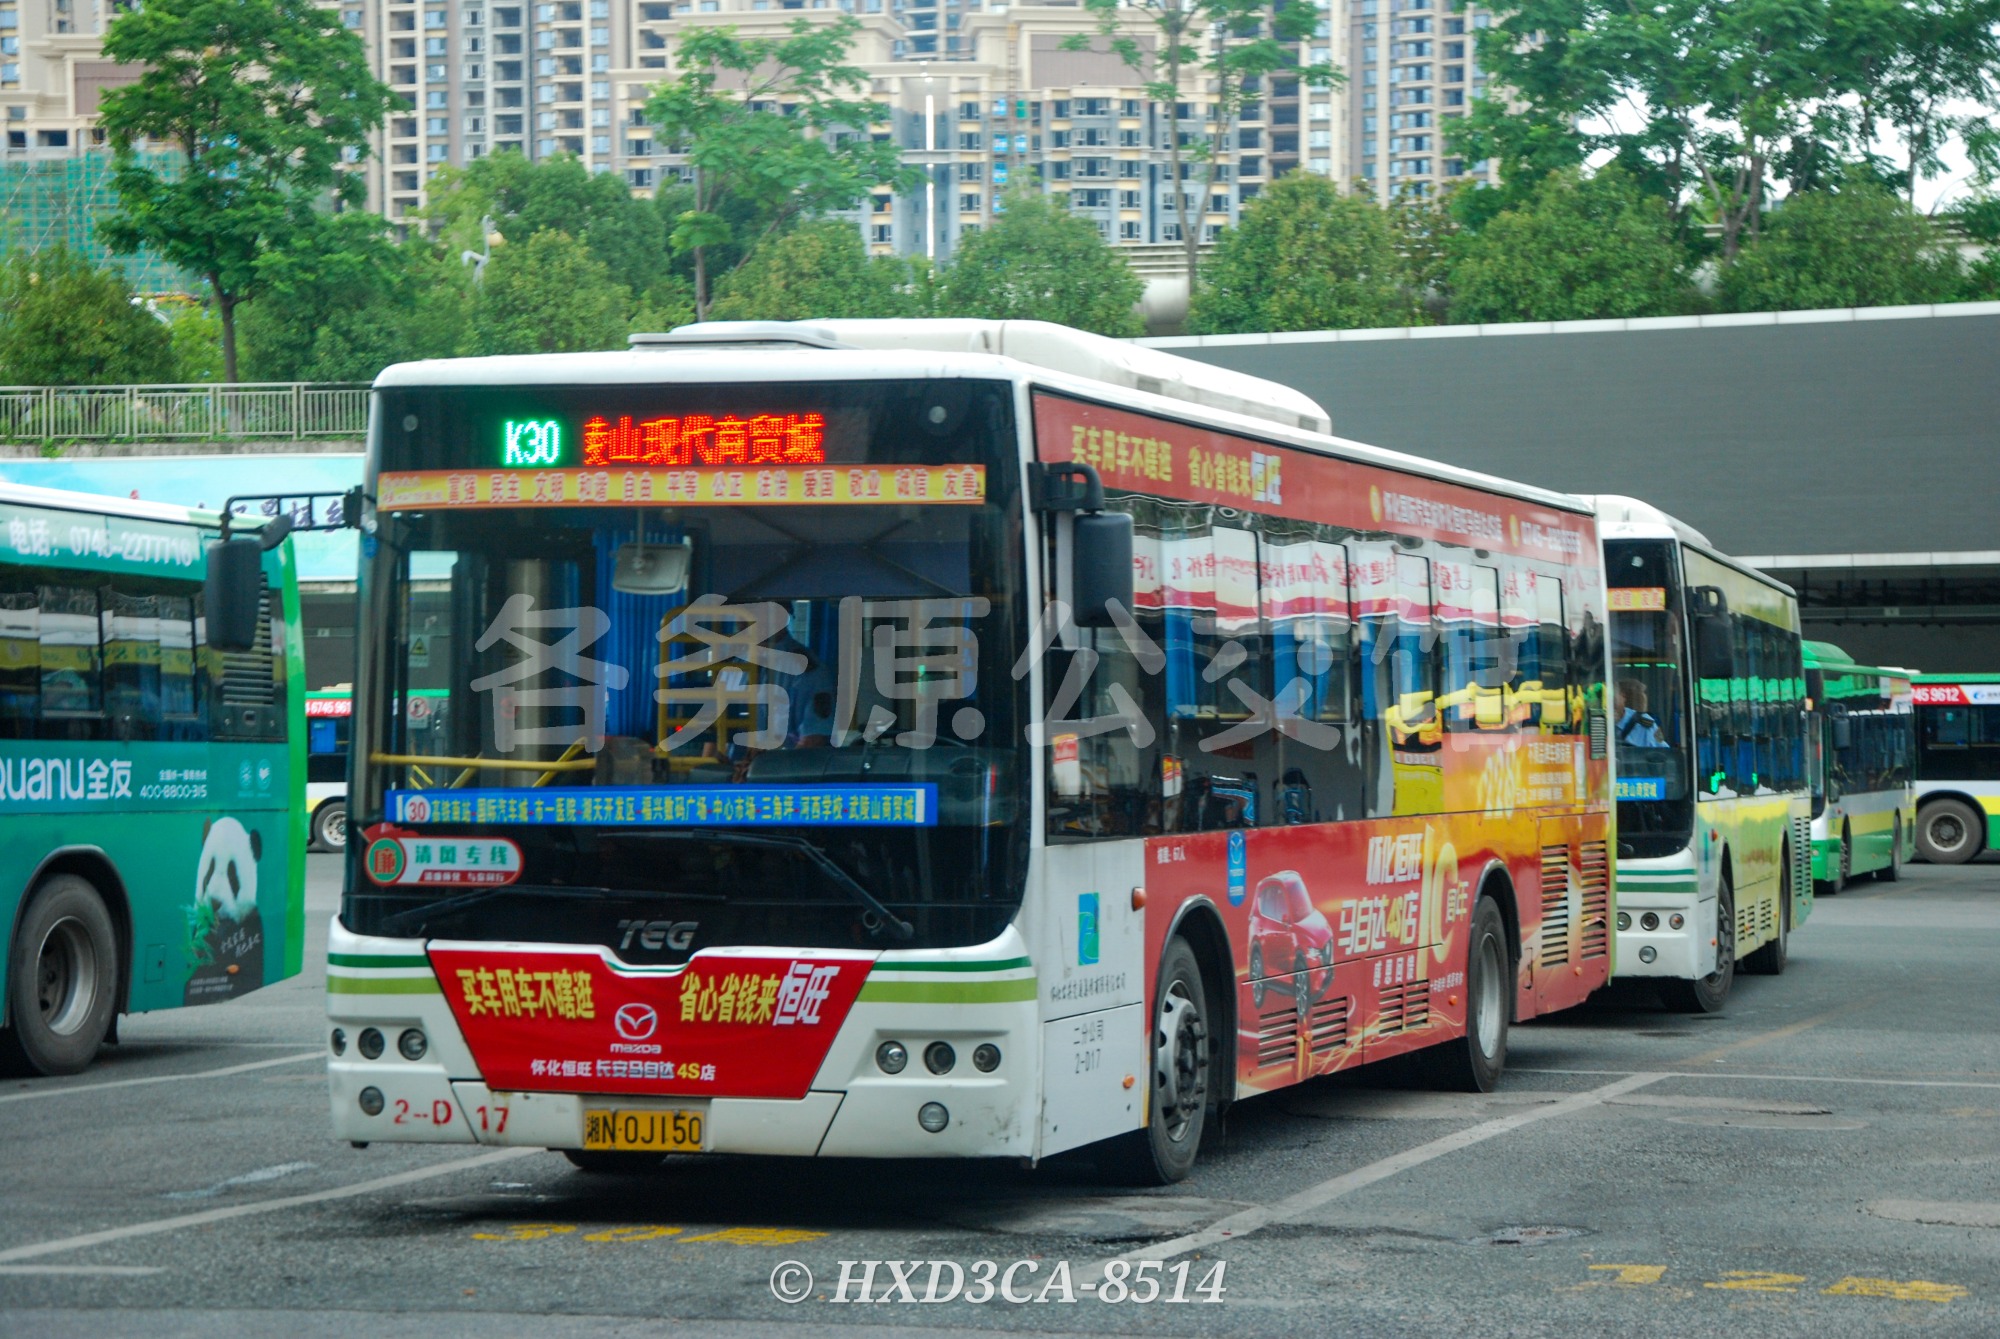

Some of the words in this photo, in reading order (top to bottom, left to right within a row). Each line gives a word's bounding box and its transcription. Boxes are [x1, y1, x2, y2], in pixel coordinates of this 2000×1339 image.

[504, 420, 560, 465] K30
[87, 758, 133, 800] 全友
[408, 801, 426, 821] 30
[617, 919, 699, 950] TEG
[1338, 890, 1420, 956] 马自达4S店
[456, 967, 596, 1019] 买车用车不瞎逛
[679, 960, 840, 1026] 省心省钱来恒旺
[610, 1043, 662, 1054] mazda
[530, 1059, 592, 1077] 怀化恒旺
[596, 1059, 675, 1079] 长安马自达
[677, 1062, 716, 1081] 4S店
